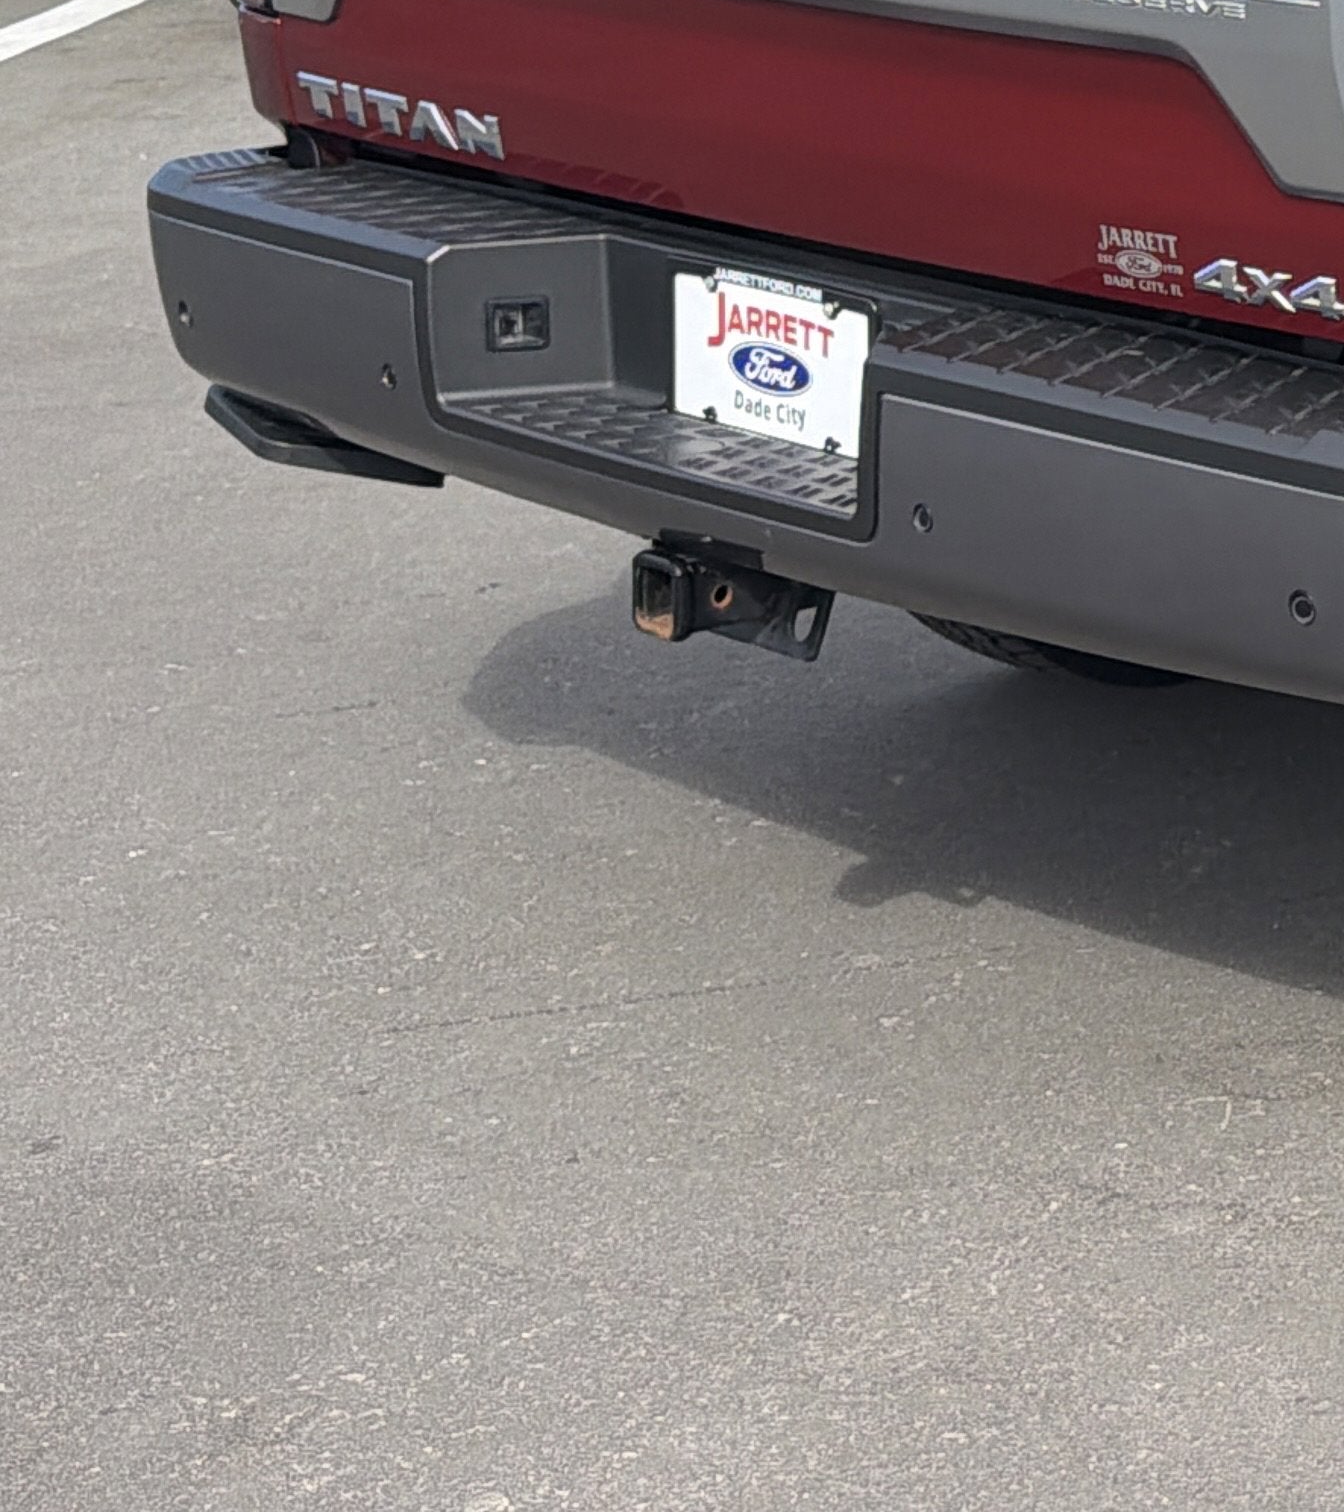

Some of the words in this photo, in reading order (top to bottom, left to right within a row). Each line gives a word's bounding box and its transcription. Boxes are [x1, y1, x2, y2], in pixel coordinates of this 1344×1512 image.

[296, 70, 505, 161] TITAN
[1097, 223, 1178, 259] JARRETT
[713, 266, 823, 304] JARRETTFORD.COM
[707, 291, 835, 358] JARRETT
[743, 347, 798, 390] Ford
[733, 389, 772, 420] Dade
[776, 401, 807, 432] City
